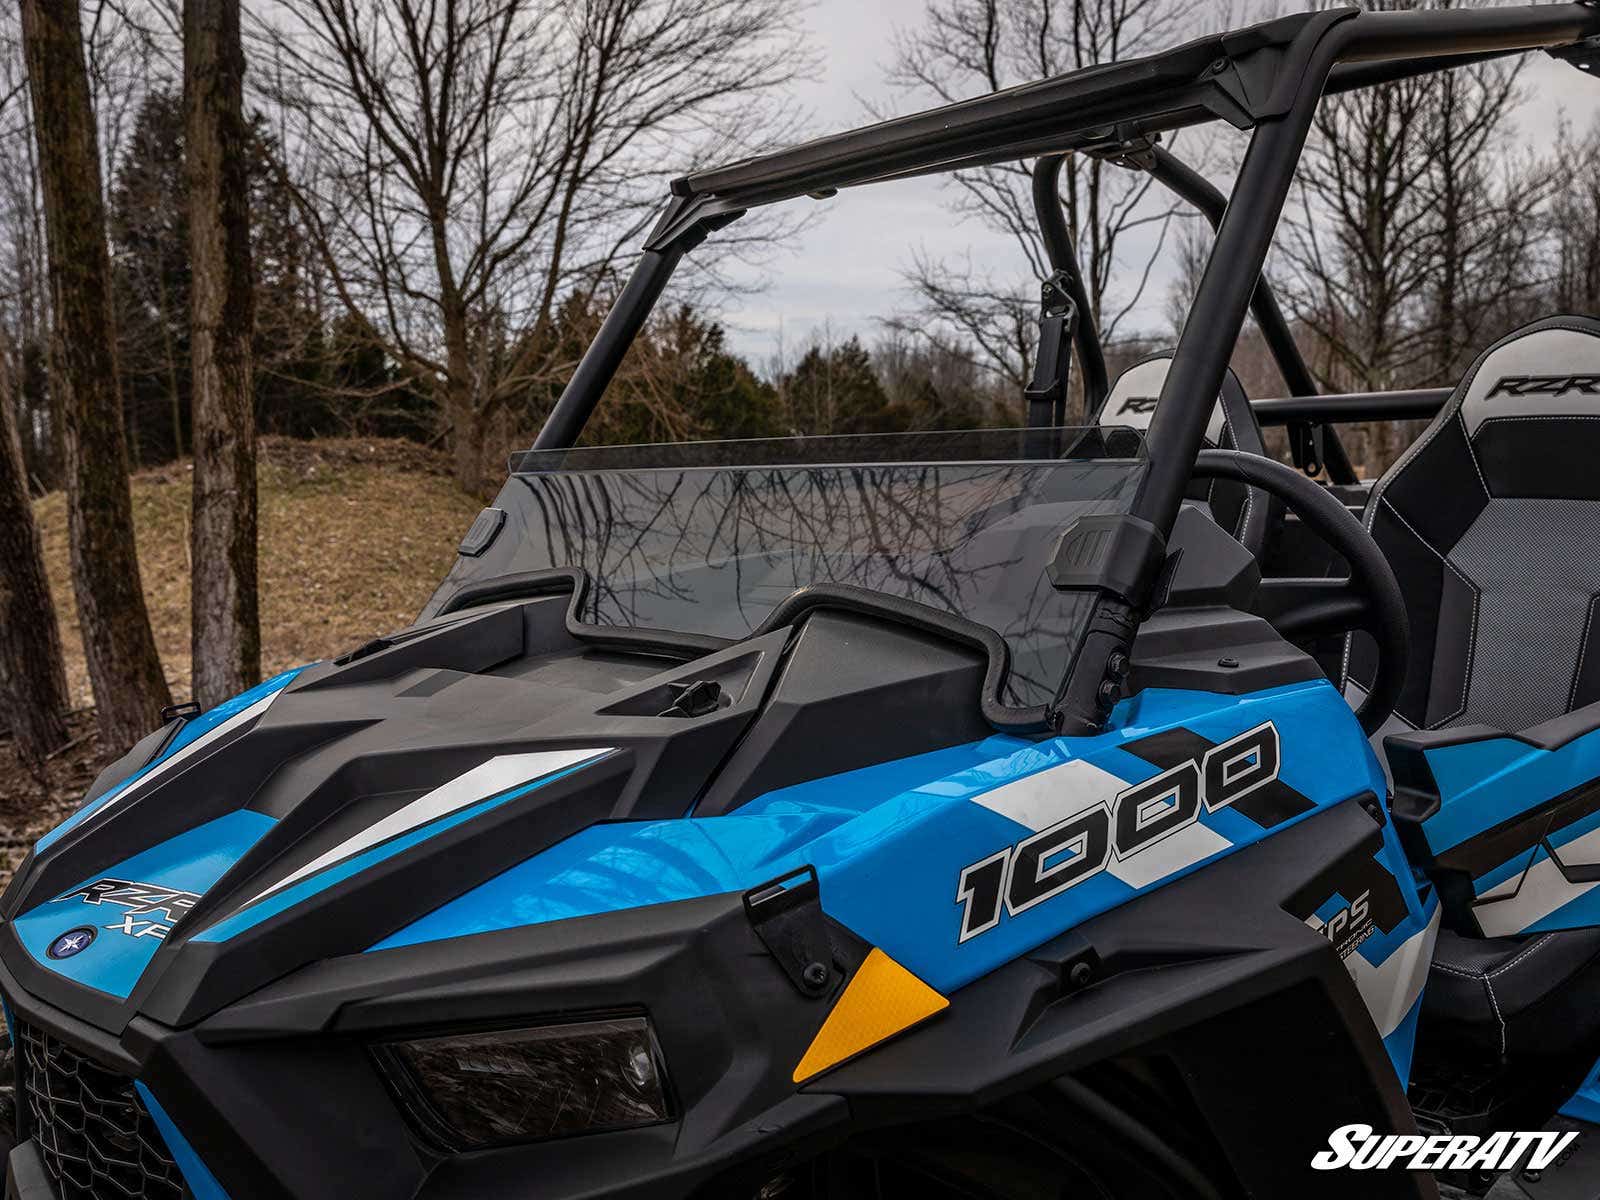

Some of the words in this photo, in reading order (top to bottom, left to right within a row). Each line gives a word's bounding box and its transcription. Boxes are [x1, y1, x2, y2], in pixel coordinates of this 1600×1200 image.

[1484, 374, 1600, 401] RZR
[955, 720, 1281, 945] 1000
[49, 877, 202, 922] RZR
[1319, 888, 1370, 942] PS
